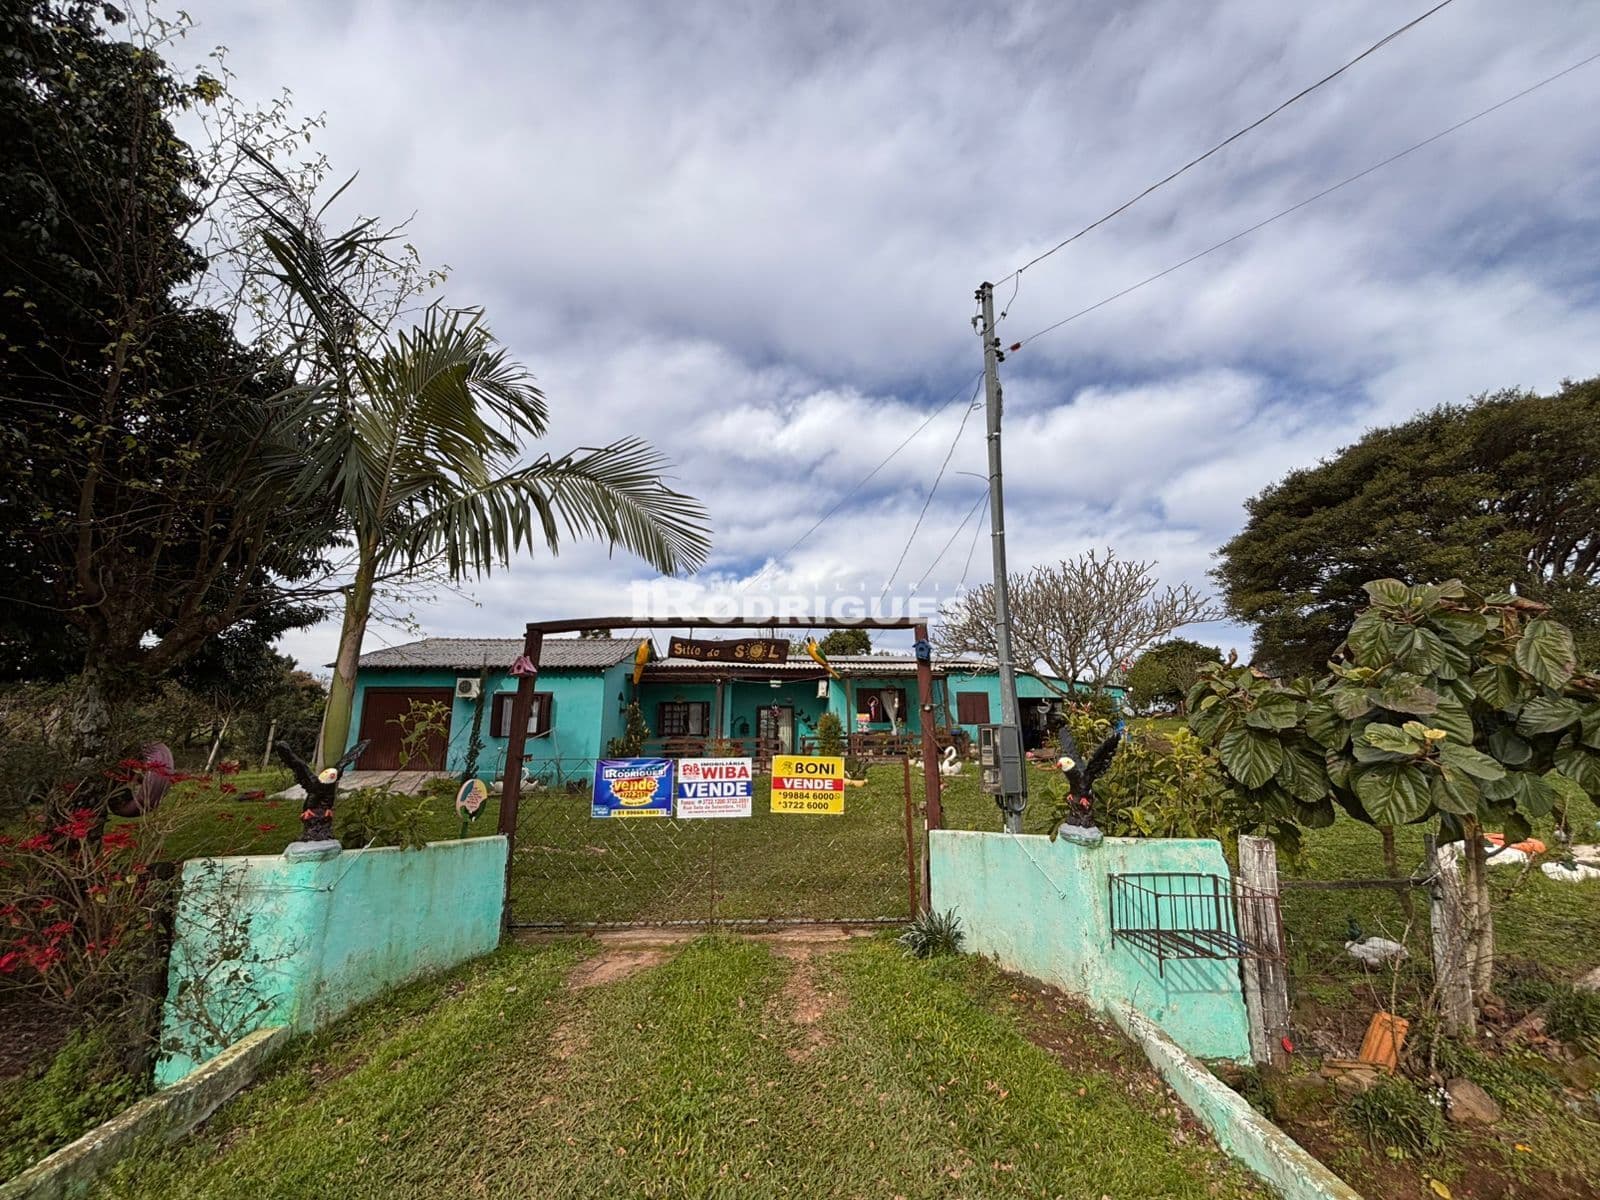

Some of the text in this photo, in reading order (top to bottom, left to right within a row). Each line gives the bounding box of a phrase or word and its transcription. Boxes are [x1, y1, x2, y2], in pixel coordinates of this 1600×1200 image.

[702, 766, 749, 779] WIBA
[795, 762, 835, 775] BONI
[614, 778, 655, 791] vende
[683, 782, 748, 797] VENDE
[782, 778, 834, 790] VENDE
[782, 792, 834, 800] 99884 6000
[782, 801, 829, 810] 3722 6000
